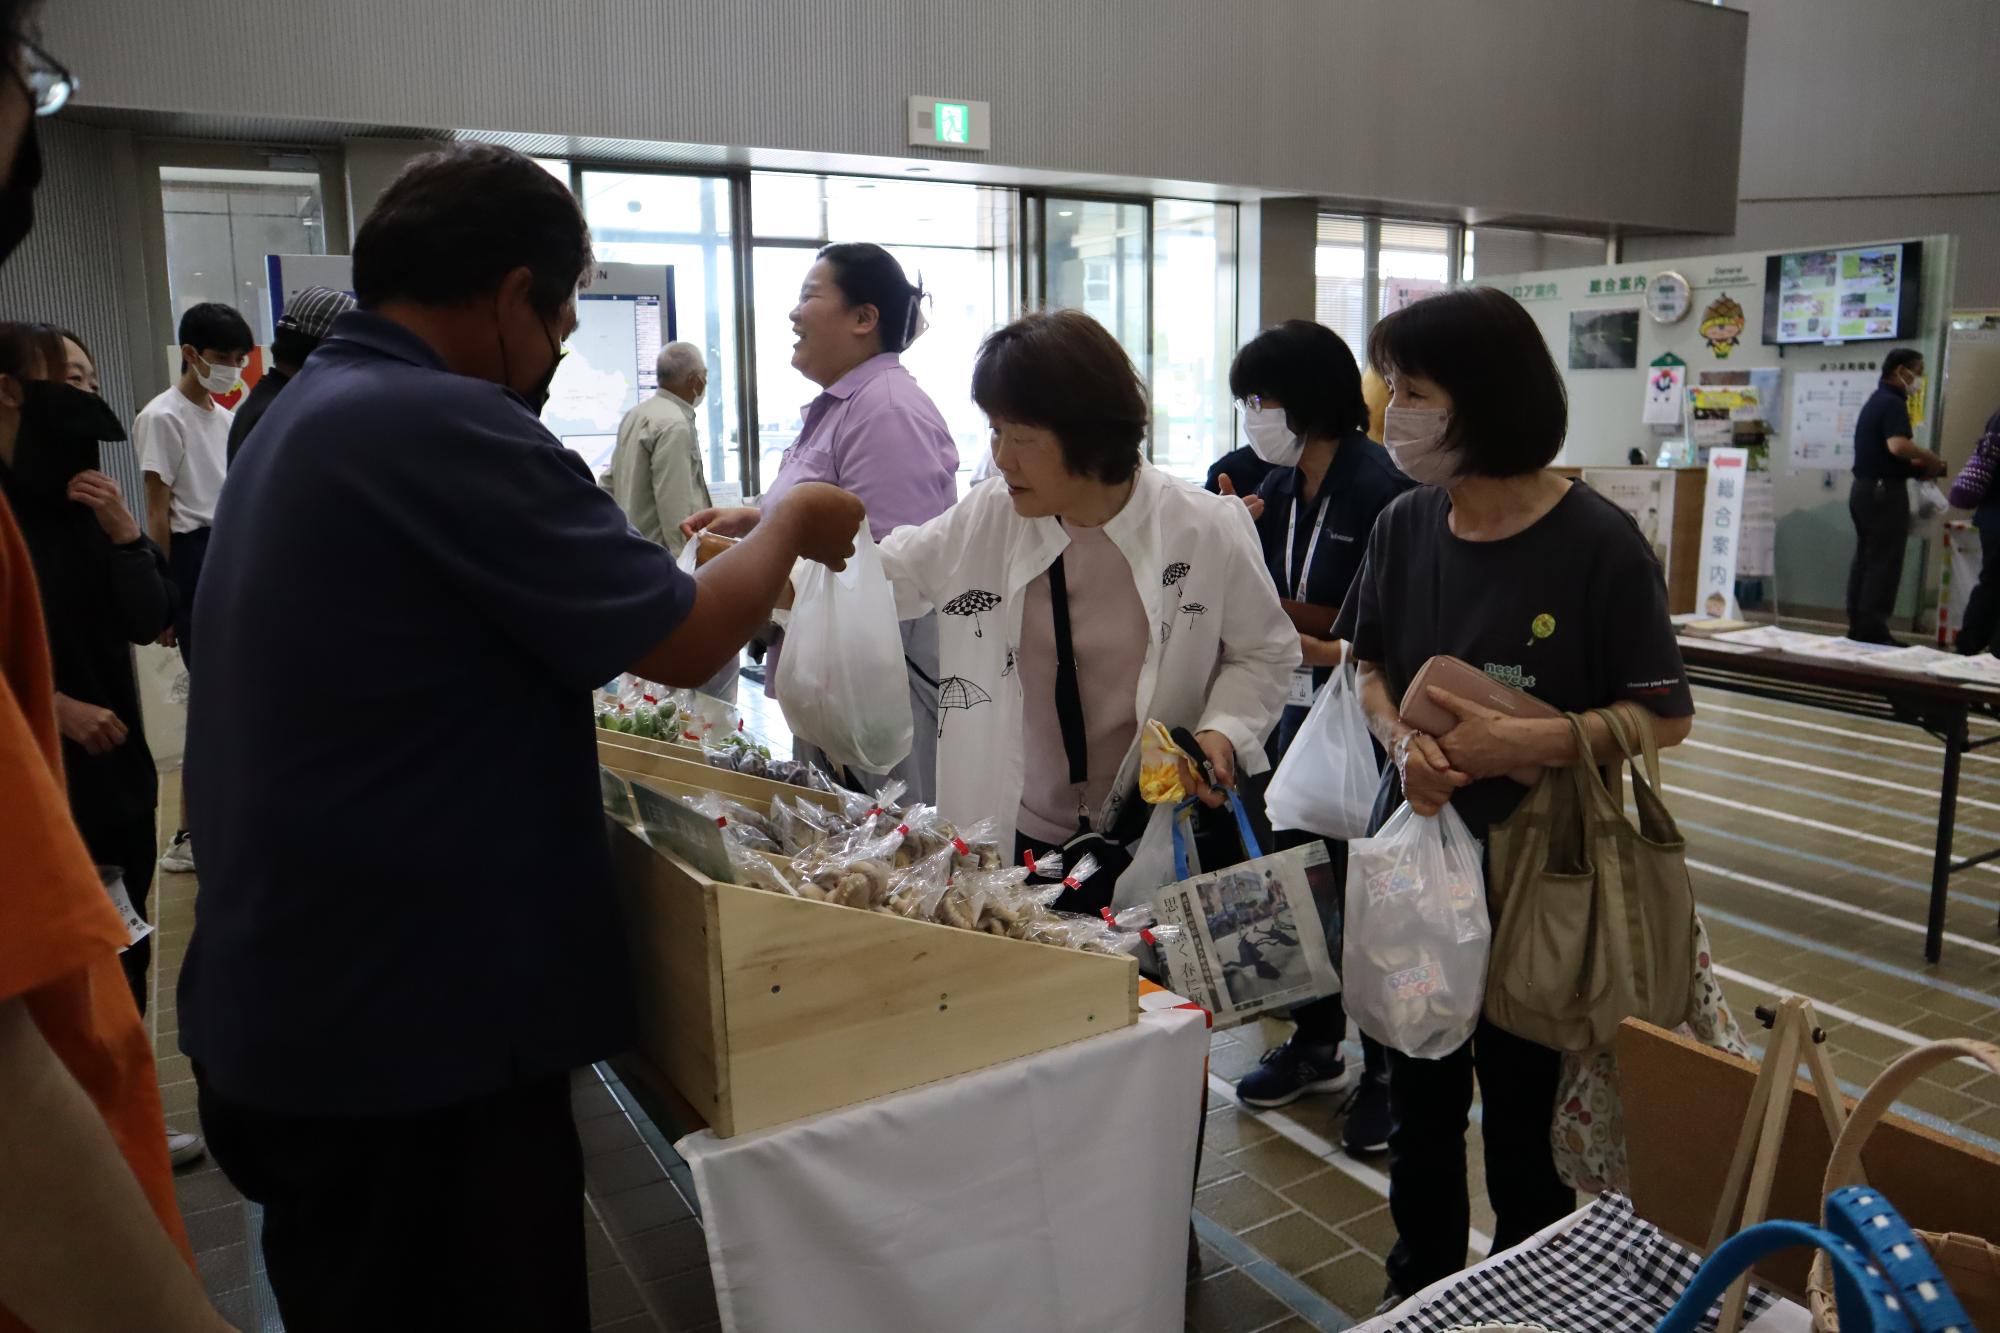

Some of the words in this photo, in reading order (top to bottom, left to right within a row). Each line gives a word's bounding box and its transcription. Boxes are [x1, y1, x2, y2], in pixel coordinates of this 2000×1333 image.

[1590, 275, 1647, 293] 総合案内
[1710, 478, 1735, 586] 総合案内
[1484, 663, 1522, 676] need
